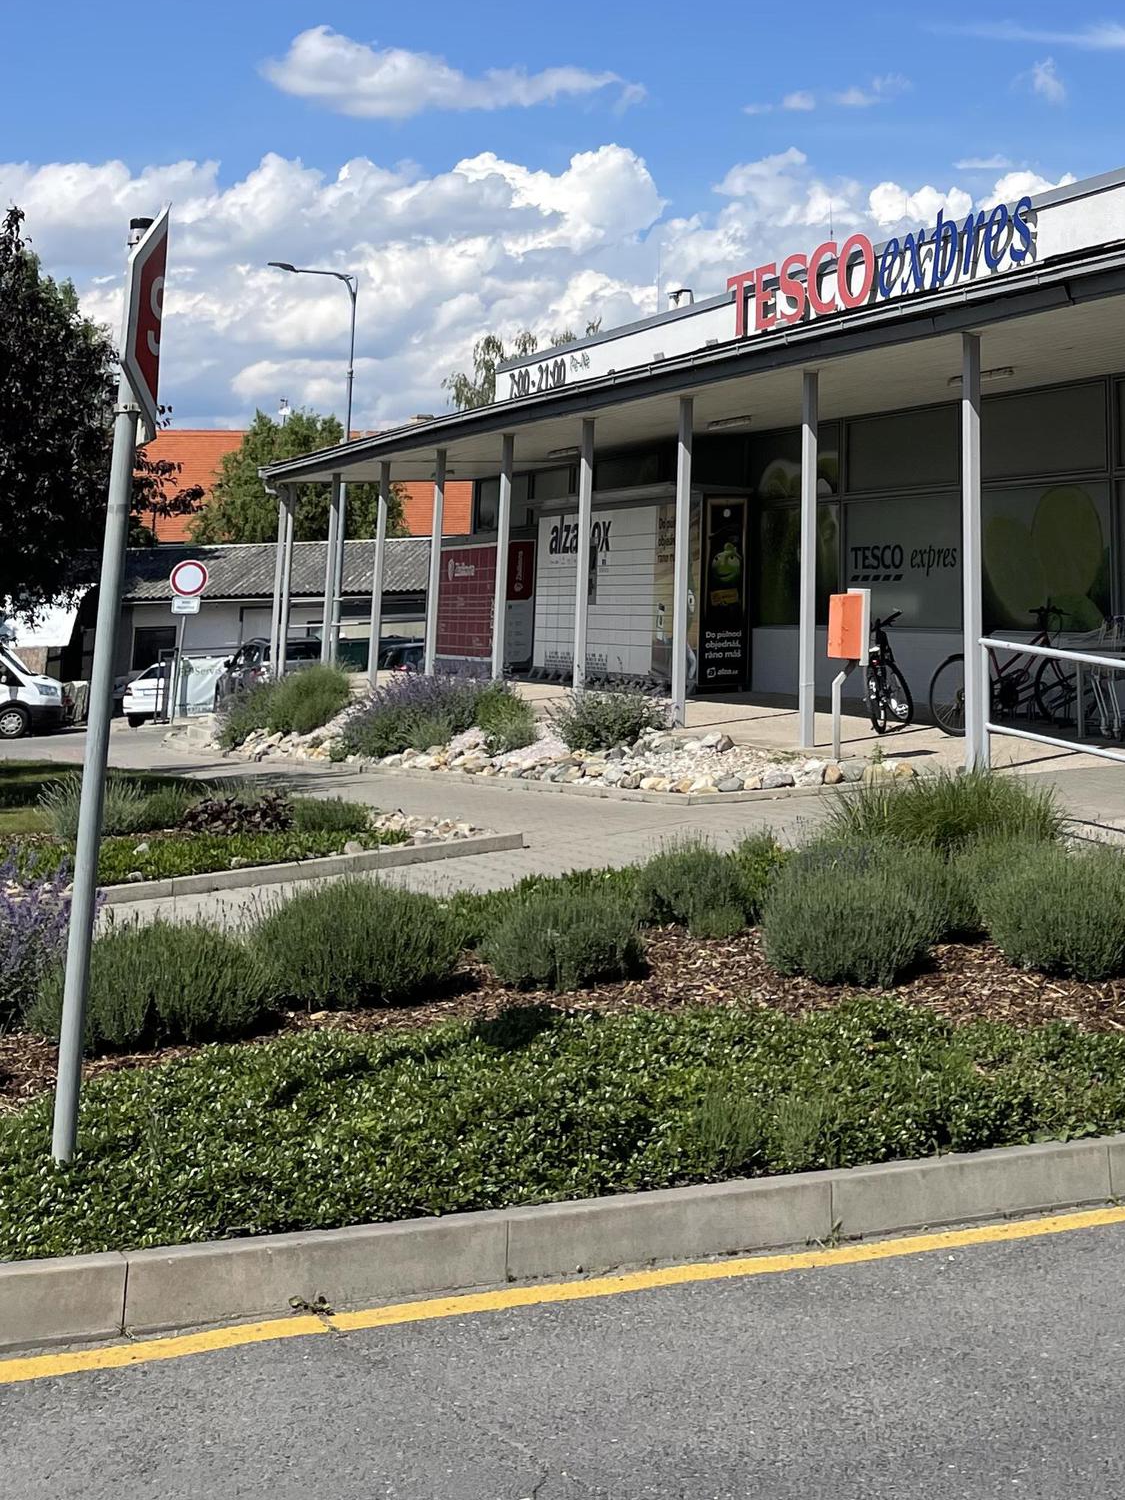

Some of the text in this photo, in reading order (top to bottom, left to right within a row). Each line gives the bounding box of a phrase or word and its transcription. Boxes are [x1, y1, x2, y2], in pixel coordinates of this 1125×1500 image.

[727, 196, 1034, 337] TESCO expres
[537, 357, 566, 392] 21:00
[549, 515, 612, 555] alzaox
[851, 545, 957, 577] TESCO expres
